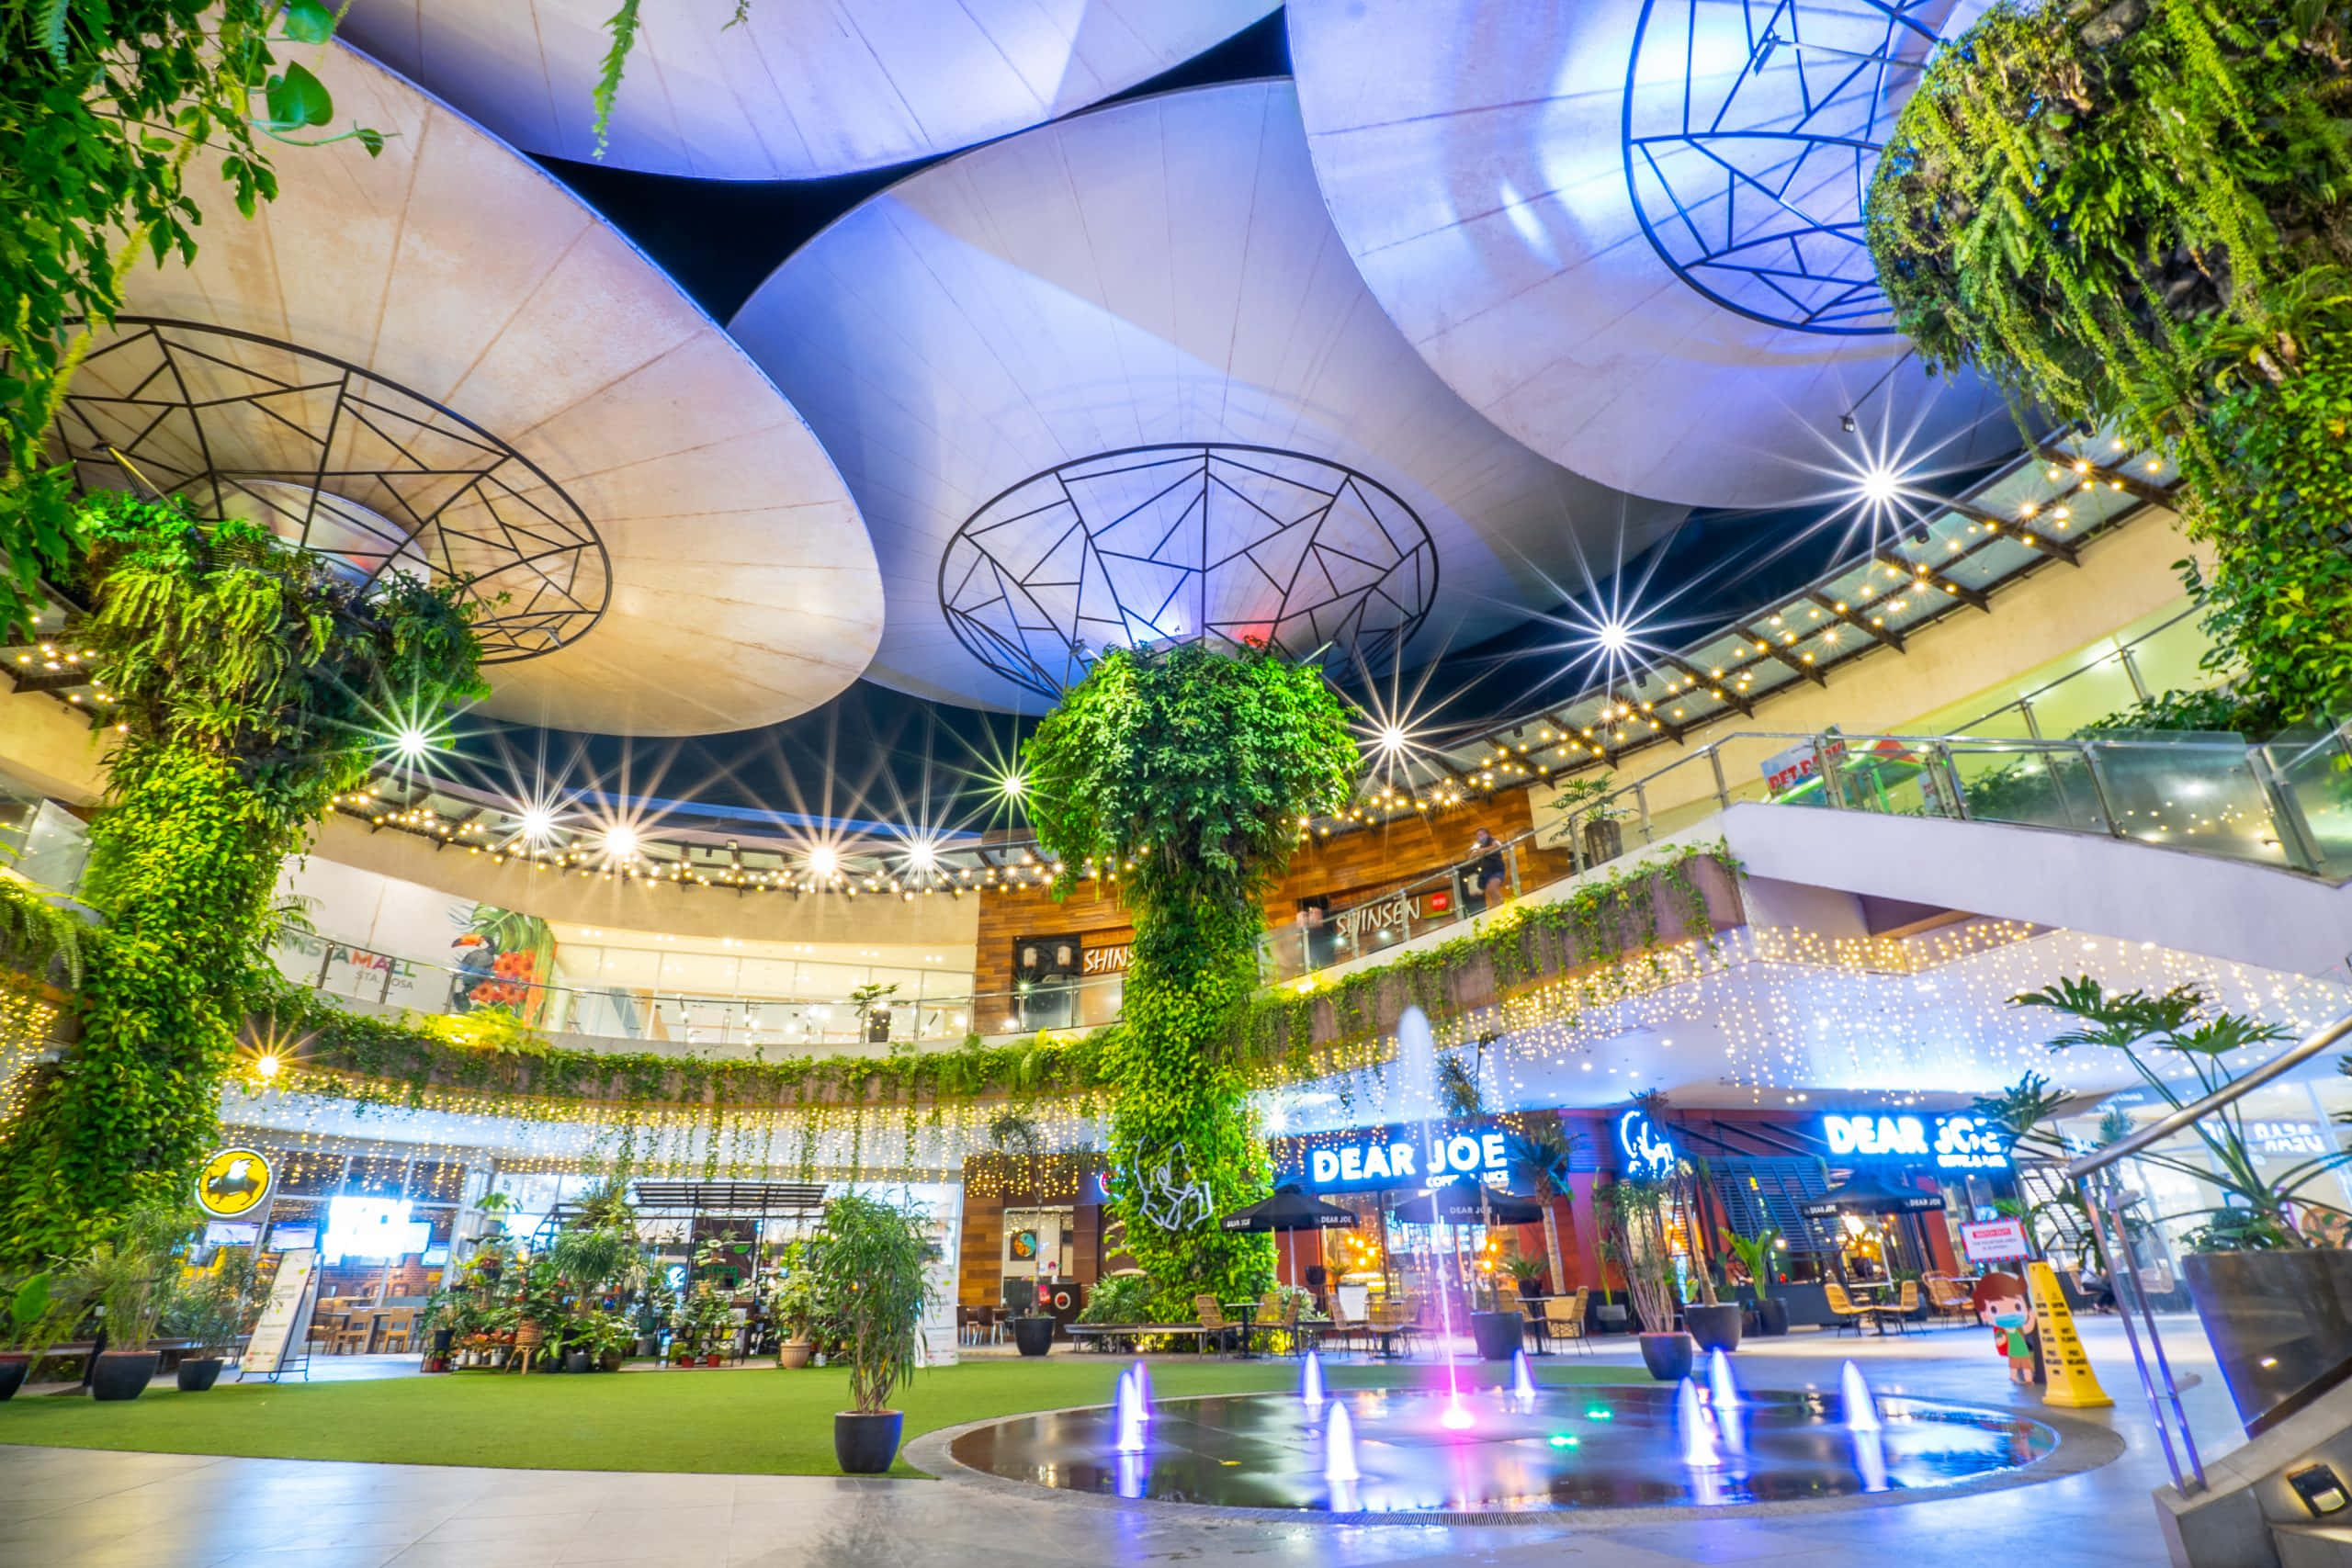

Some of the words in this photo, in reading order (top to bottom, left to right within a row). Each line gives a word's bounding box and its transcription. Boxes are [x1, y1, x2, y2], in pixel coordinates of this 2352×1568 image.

[391, 977, 413, 990] OSA
[1823, 1116, 1929, 1155] DEAR
[1312, 1143, 1416, 1183] DEAR
[1426, 1133, 1508, 1174] JOE
[1449, 1205, 1474, 1214] DEAR
[1320, 1215, 1339, 1224] DEAR
[1340, 1215, 1352, 1224] JOE
